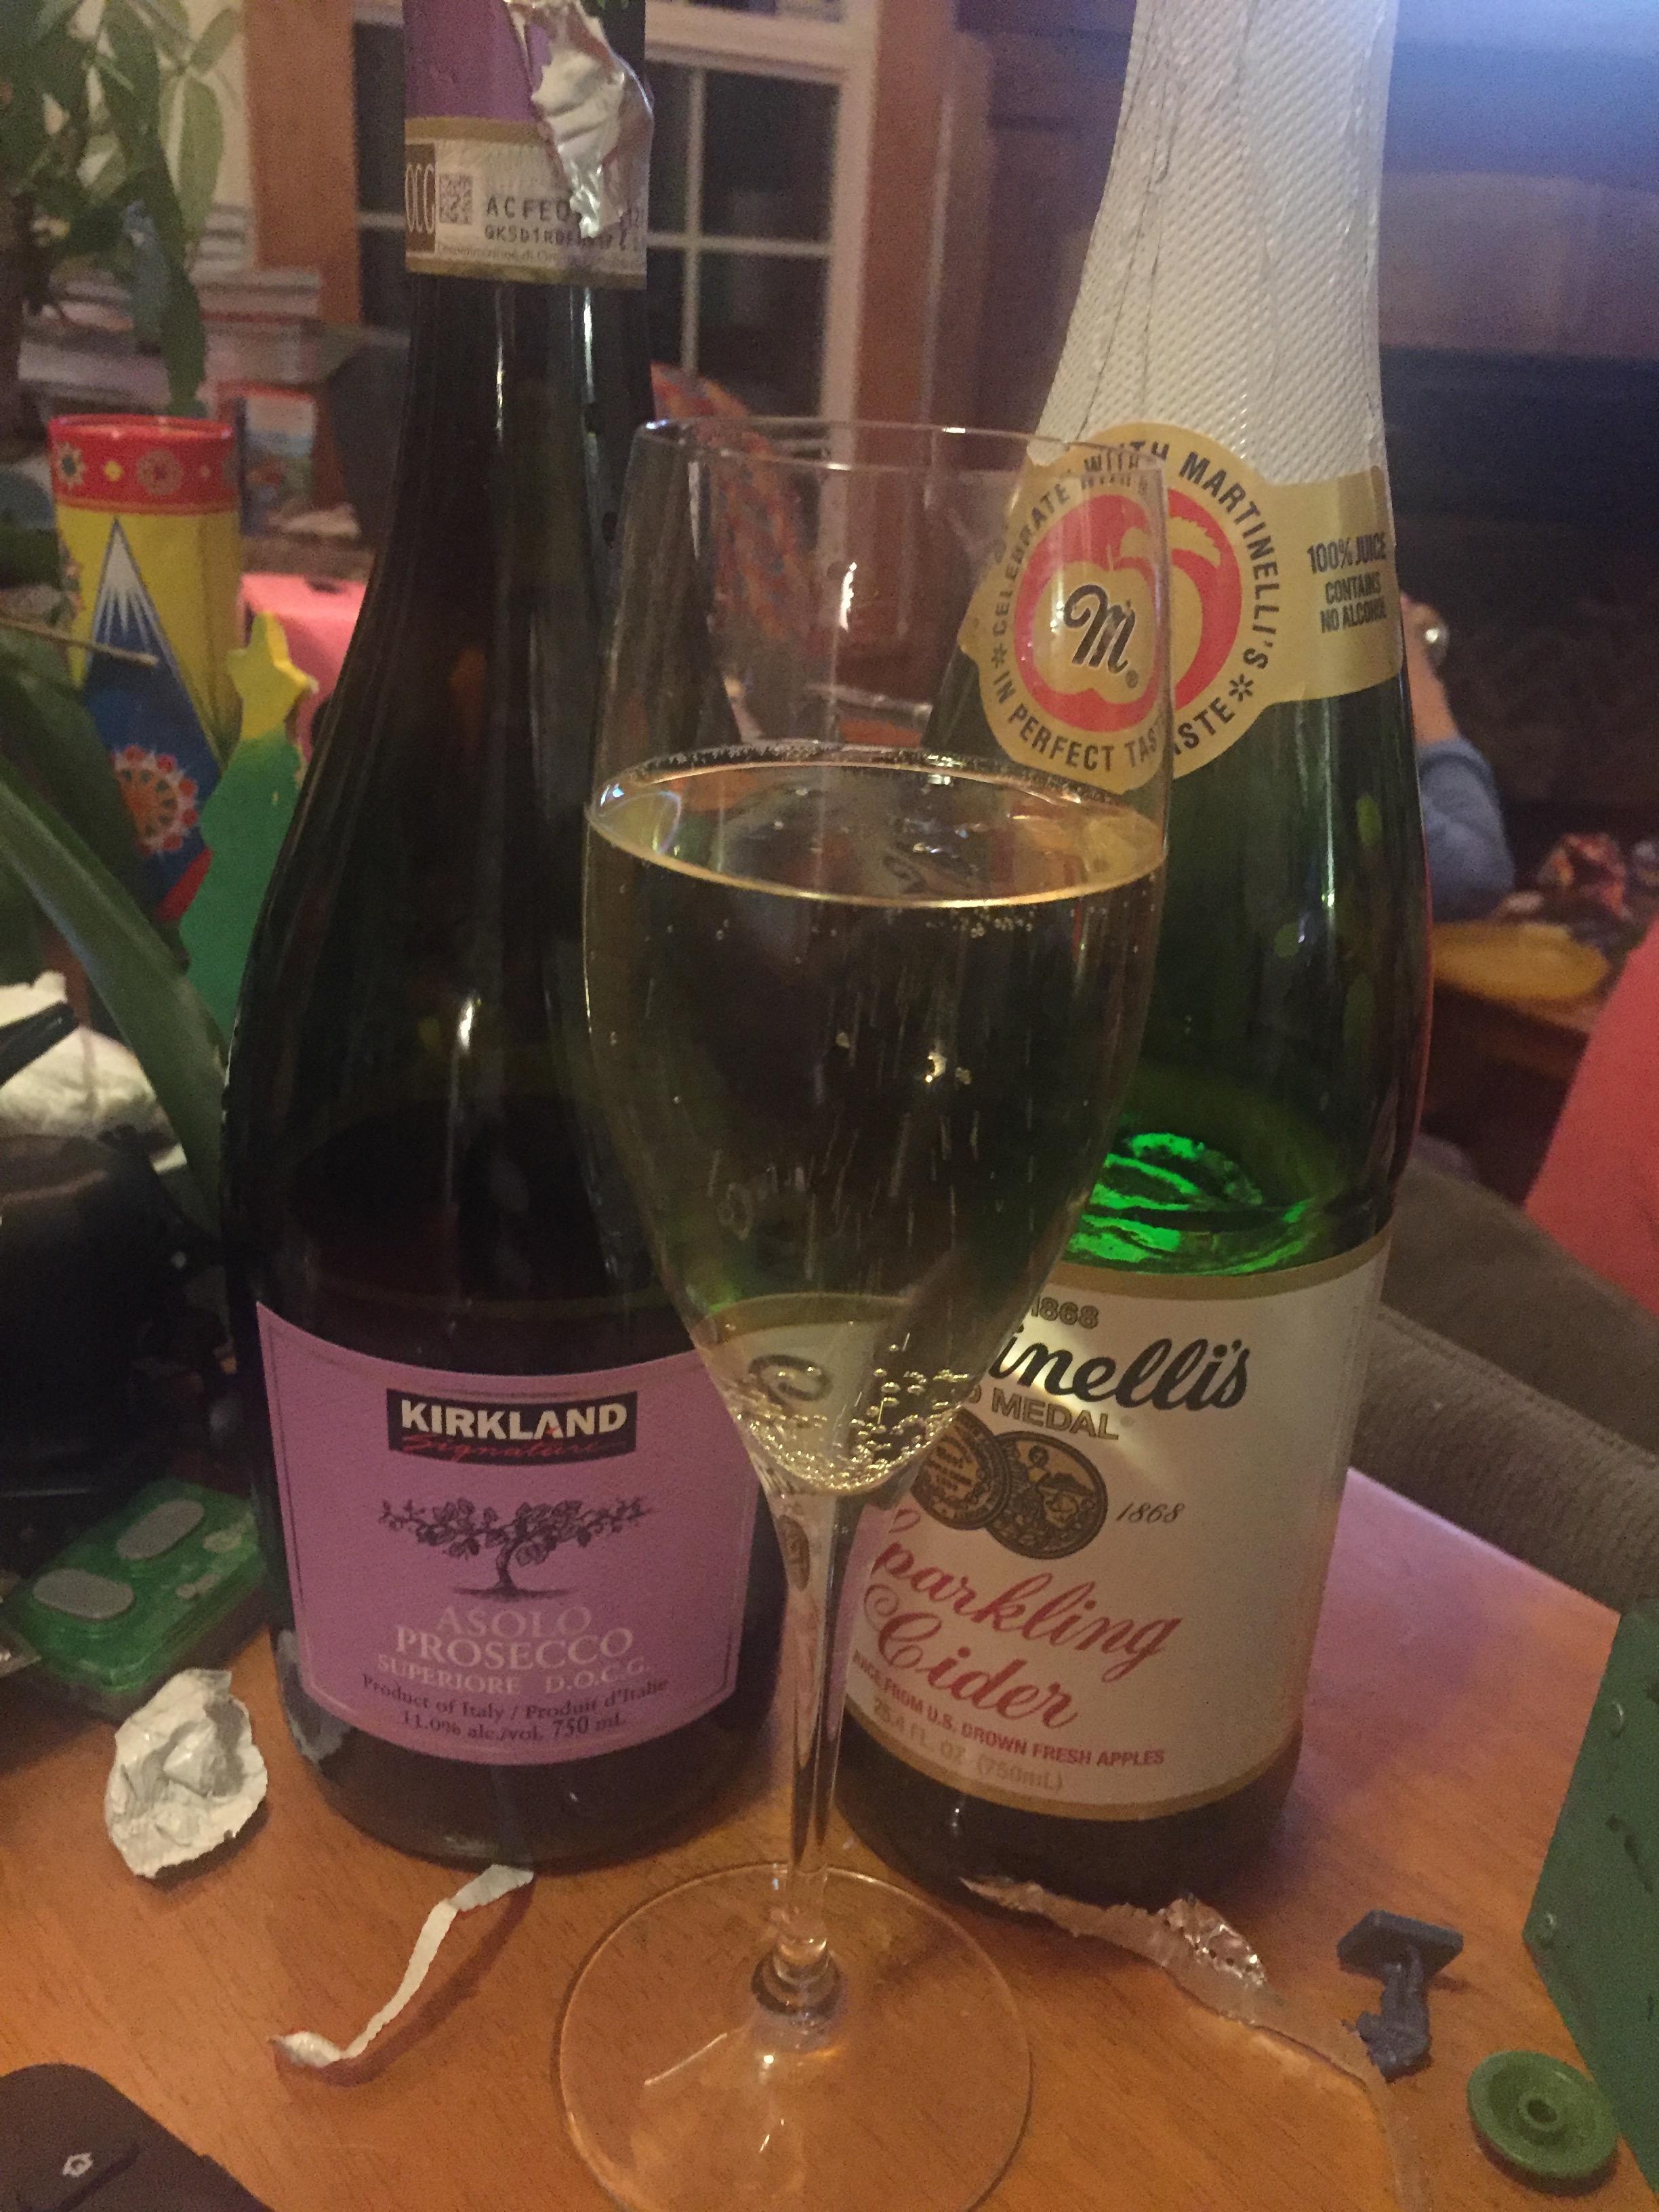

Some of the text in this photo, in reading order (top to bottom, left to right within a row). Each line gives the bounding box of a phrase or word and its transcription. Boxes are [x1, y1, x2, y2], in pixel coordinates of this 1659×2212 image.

[1179, 451, 1279, 670] MARTINELLI'S
[1307, 536, 1353, 574] 100%
[1325, 571, 1382, 605] CONTAINS
[1319, 597, 1387, 634] NO ALCOHOL
[993, 671, 1016, 704] IN
[1008, 702, 1115, 773] PERFECT
[987, 1323, 1250, 1412] inelli's
[401, 1399, 628, 1440] KIRKLAND
[991, 1387, 1120, 1441] MEDAL
[1115, 1502, 1185, 1524] 1868
[435, 1605, 592, 1639] ASOLO
[394, 1624, 634, 1671] PROSECCO
[863, 1583, 1079, 1729] Cider
[377, 1654, 521, 1694] SUPERIORE
[363, 1673, 428, 1709] Product
[435, 1699, 457, 1715] of
[462, 1700, 505, 1724] Italy
[525, 1696, 598, 1720] Produit
[552, 1715, 590, 1738] 750
[883, 1676, 924, 1715] FROM
[1031, 1741, 1092, 1765] FRESH
[1096, 1748, 1165, 1767] APPLES
